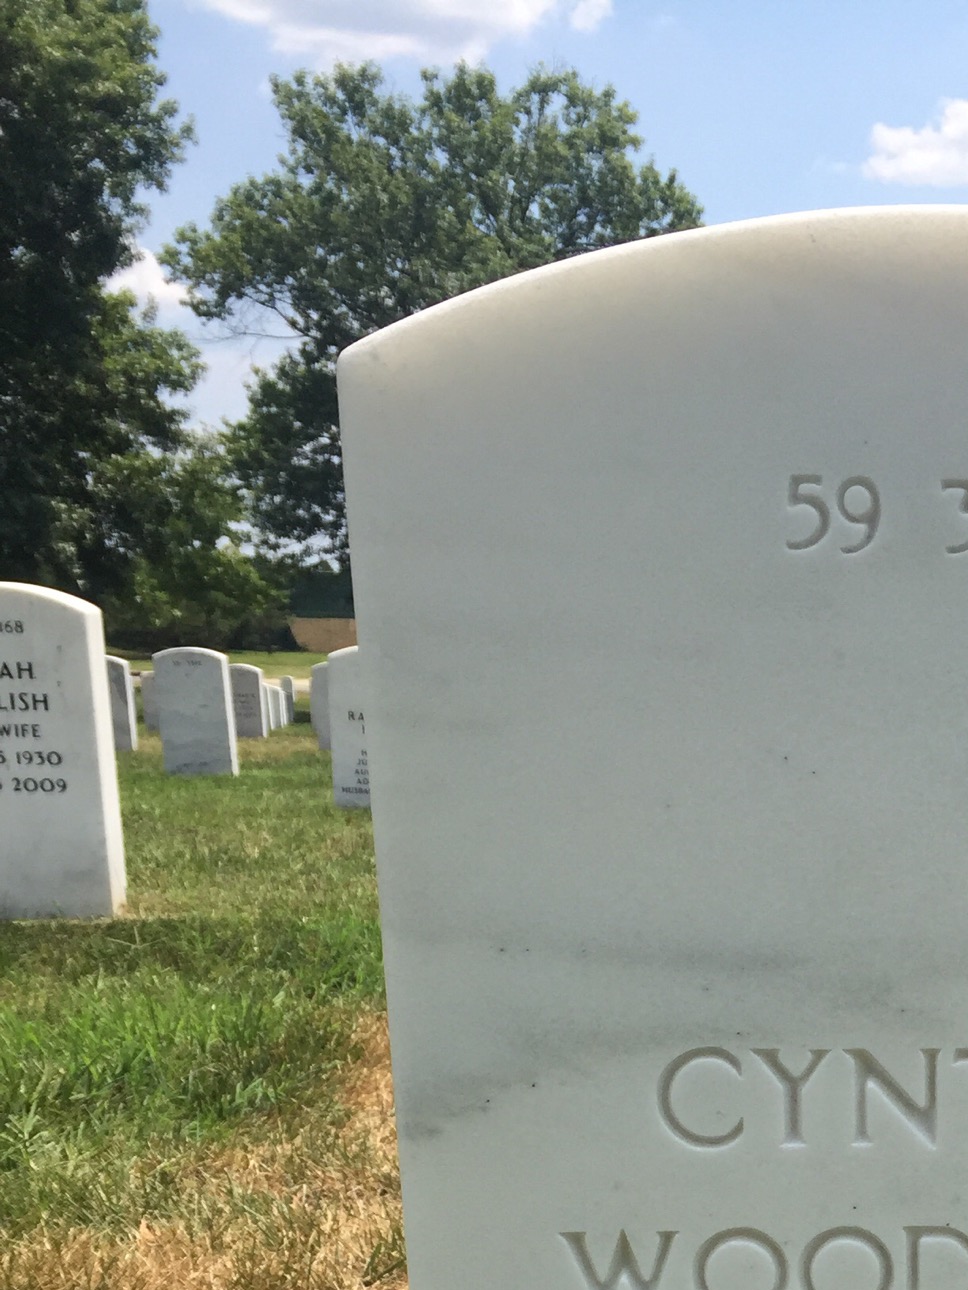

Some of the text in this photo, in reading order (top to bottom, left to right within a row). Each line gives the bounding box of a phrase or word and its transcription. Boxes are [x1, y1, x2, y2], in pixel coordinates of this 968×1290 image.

[786, 473, 882, 554] 59
[16, 750, 62, 766] 1930
[11, 777, 67, 793] 2009
